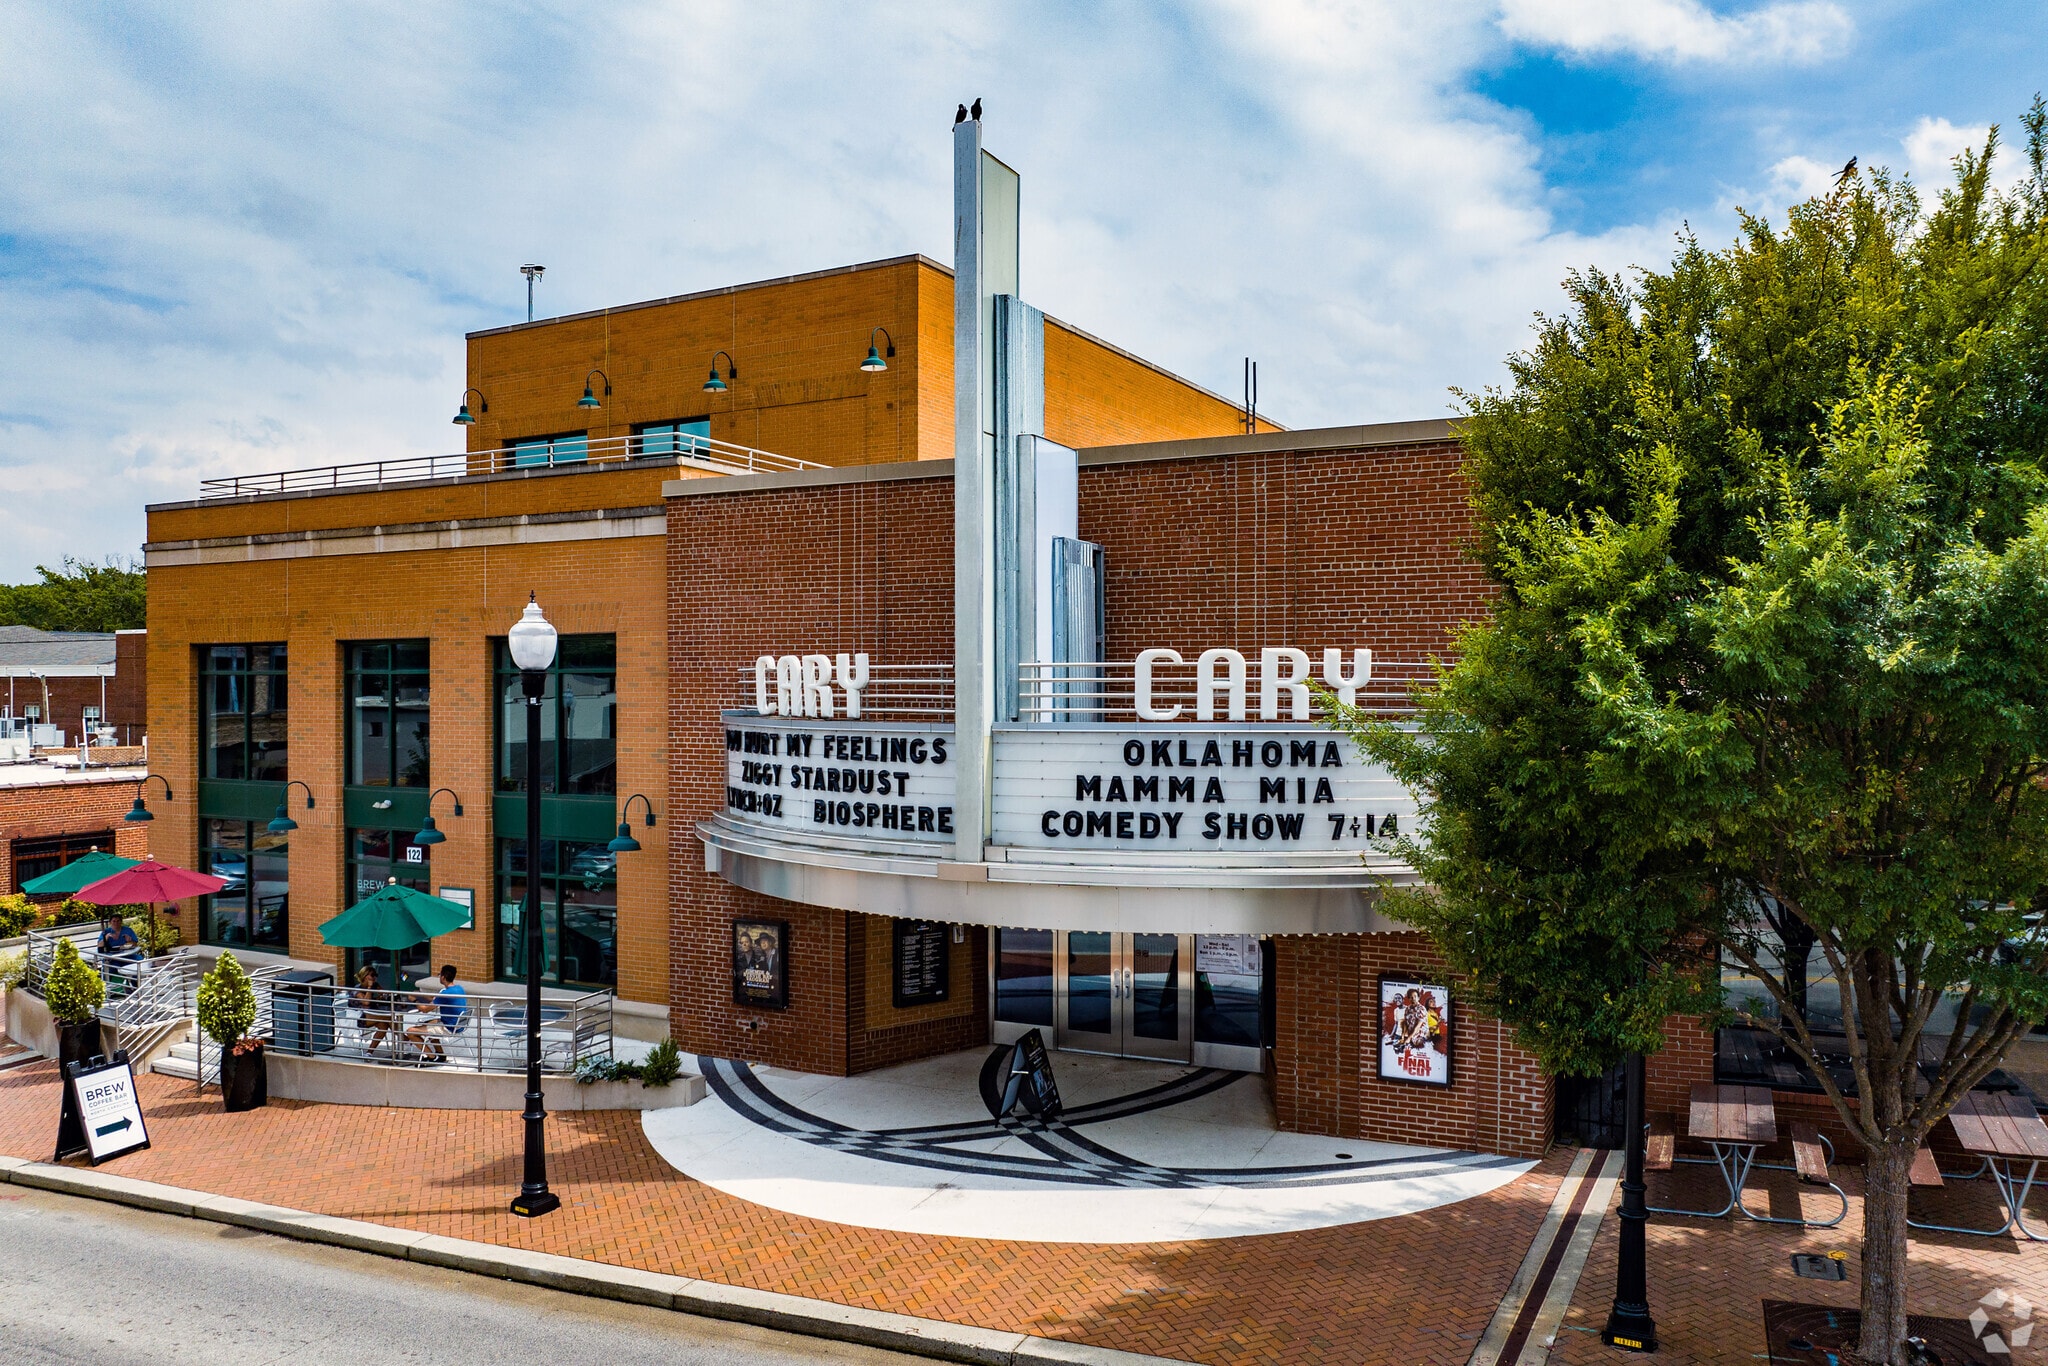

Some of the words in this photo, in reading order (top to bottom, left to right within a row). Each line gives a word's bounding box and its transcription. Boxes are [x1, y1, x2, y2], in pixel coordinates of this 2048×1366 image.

[755, 653, 869, 719] CARY
[1134, 647, 1372, 721] CARY
[786, 733, 813, 758] MY
[823, 734, 947, 764] FEELINGS
[1123, 739, 1343, 768] OKLAHOMA
[741, 760, 782, 787] ZIGGY
[790, 763, 910, 797] STARDUST
[1075, 774, 1226, 804] MAMMA
[1259, 776, 1336, 804] MIA
[813, 799, 954, 835] BIOSPHERE
[1041, 810, 1184, 839] COMEDY
[1201, 811, 1305, 841] SHOW
[408, 849, 421, 861] 122
[357, 879, 385, 890] BREW
[1398, 1055, 1431, 1070] FINAL
[1408, 1067, 1431, 1077] CUT
[86, 1081, 124, 1101] BREW
[88, 1097, 112, 1108] COFFEE
